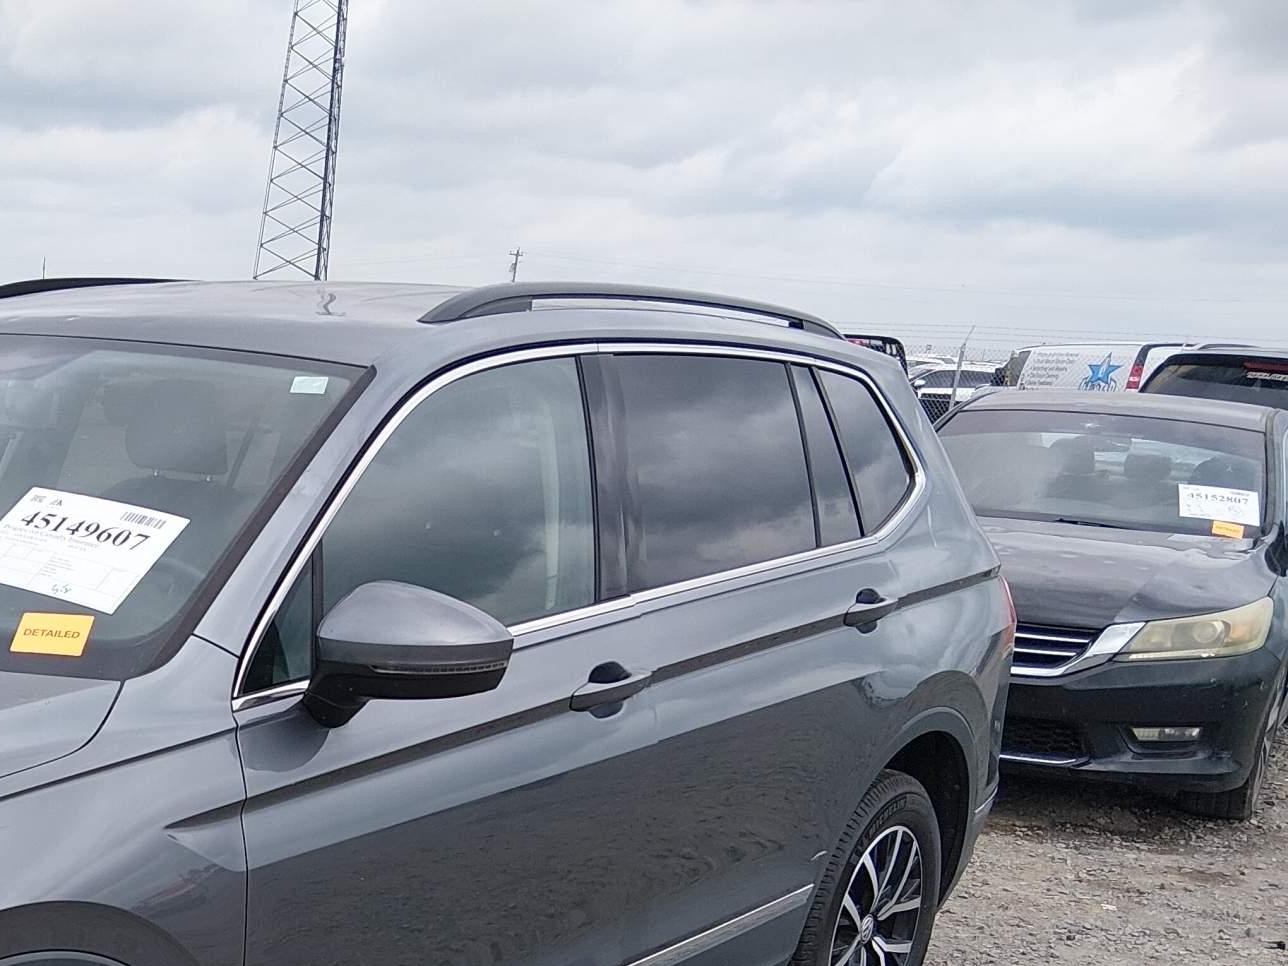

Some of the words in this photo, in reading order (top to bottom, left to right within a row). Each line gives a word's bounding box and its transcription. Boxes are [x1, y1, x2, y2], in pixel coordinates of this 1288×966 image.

[1187, 492, 1249, 505] 45152807
[21, 511, 151, 550] 45149607
[23, 627, 81, 640] DETAILED
